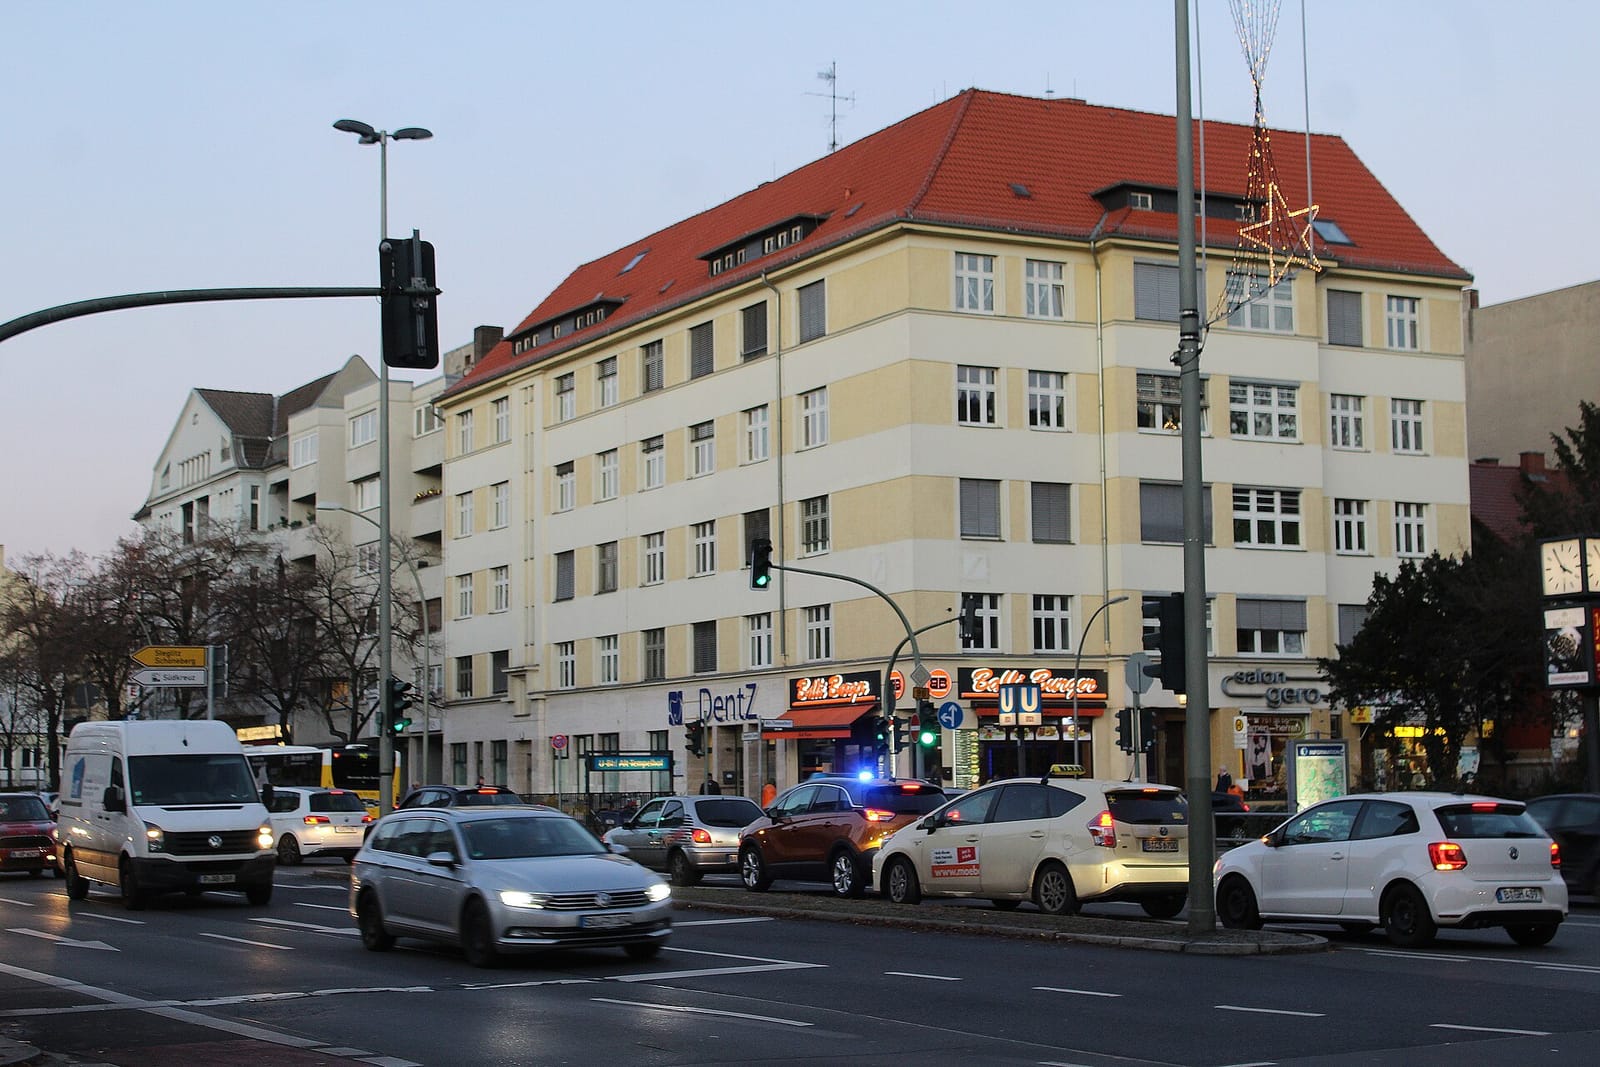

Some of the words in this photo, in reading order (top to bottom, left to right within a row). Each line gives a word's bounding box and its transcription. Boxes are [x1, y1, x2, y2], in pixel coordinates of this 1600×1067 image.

[1234, 669, 1287, 684] salon
[699, 682, 757, 722] DentZ
[1001, 686, 1014, 713] U
[1021, 686, 1039, 713] U
[1265, 688, 1320, 708] gero
